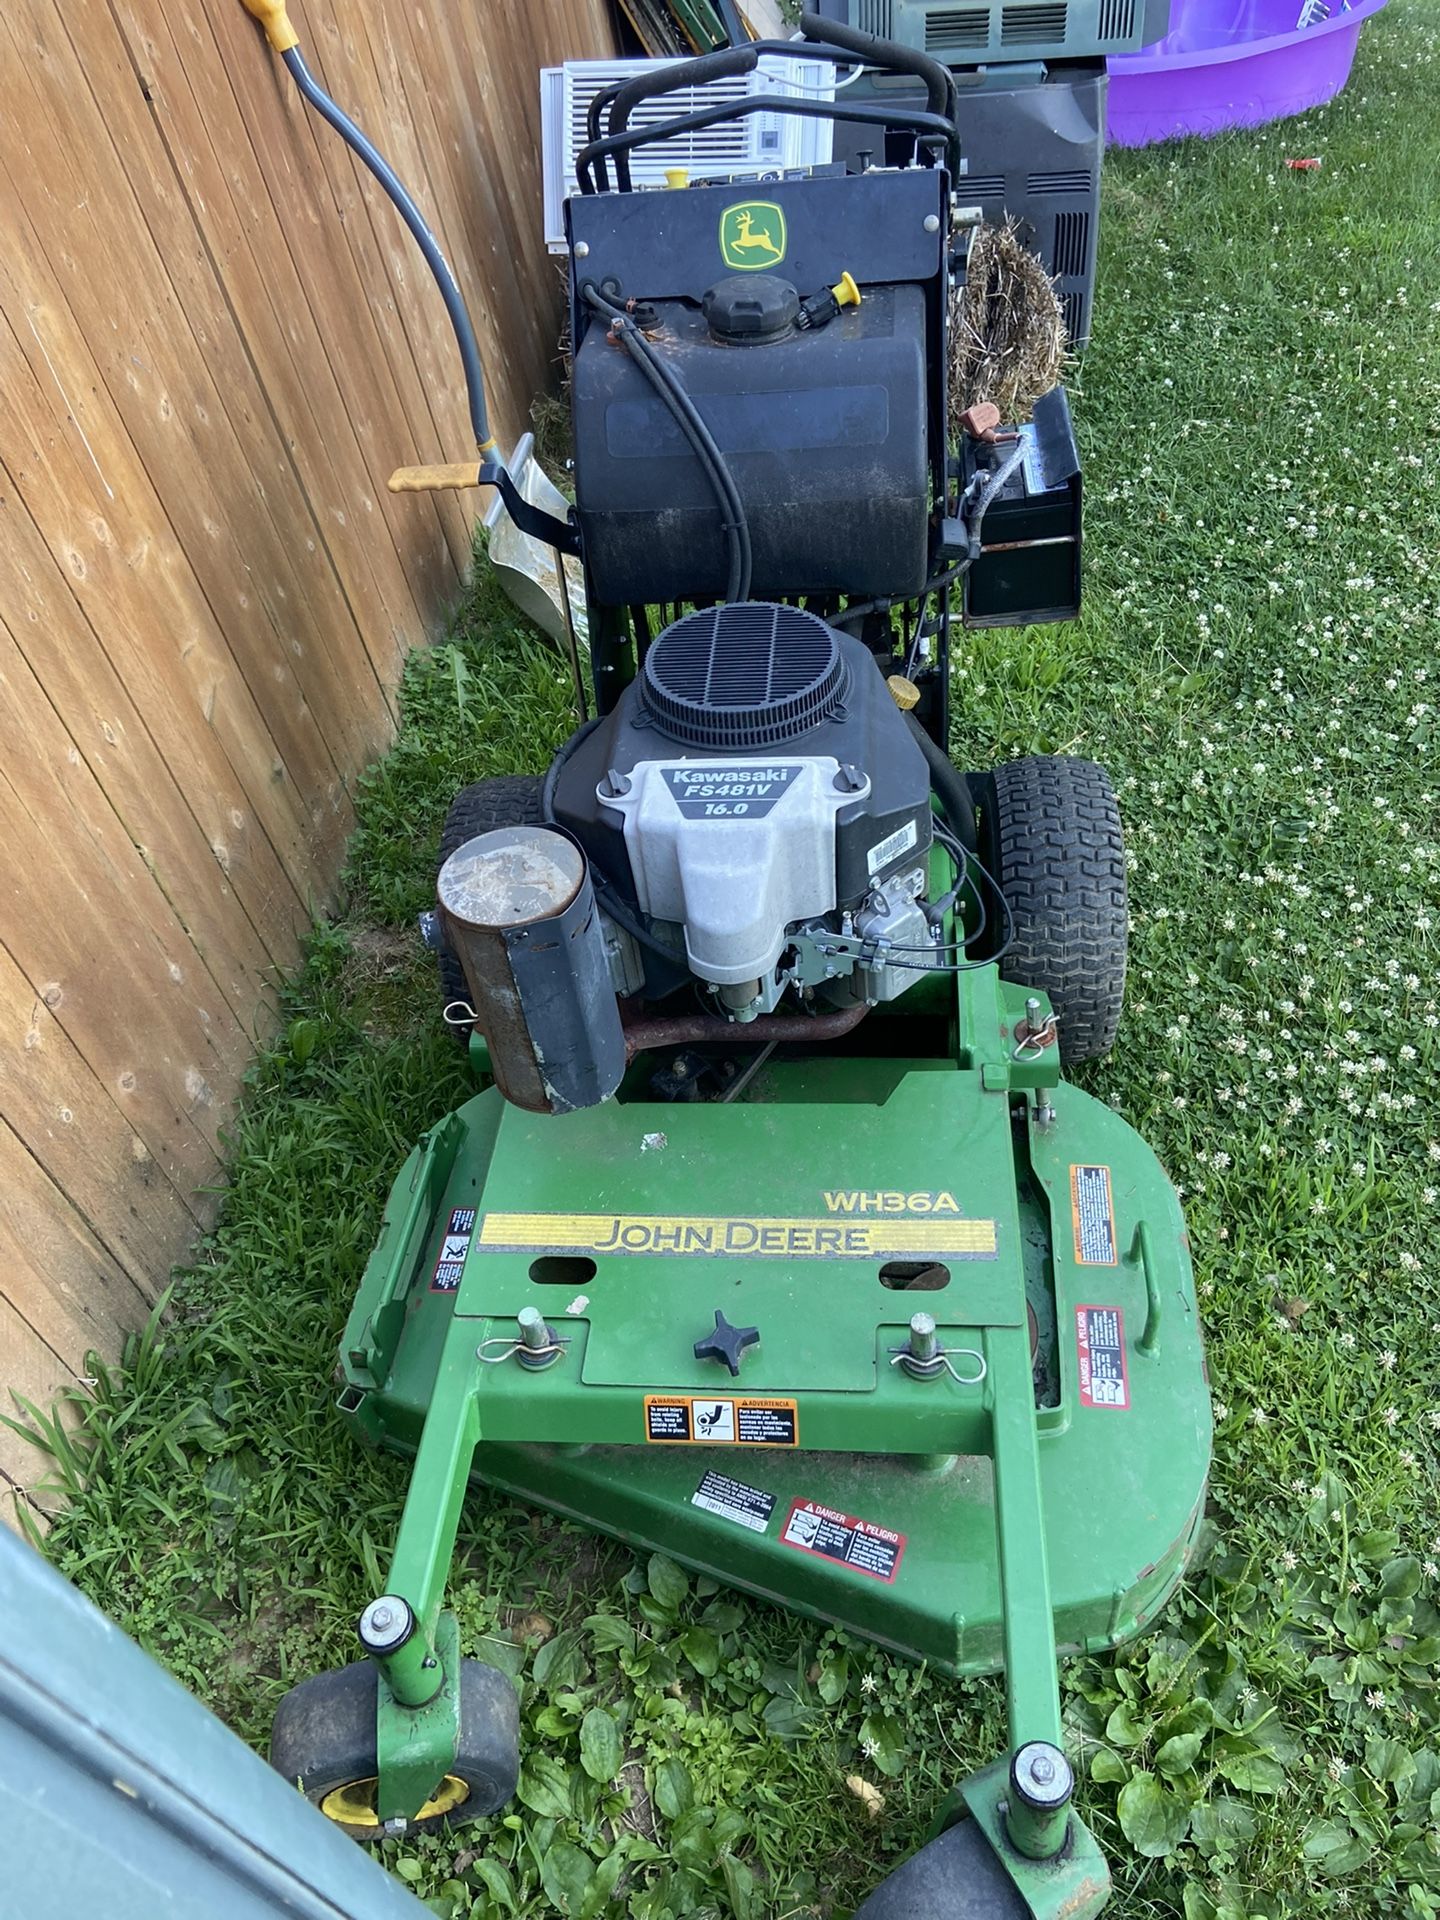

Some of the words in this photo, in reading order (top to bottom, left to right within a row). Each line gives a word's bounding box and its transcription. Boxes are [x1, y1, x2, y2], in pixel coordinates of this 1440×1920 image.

[673, 769, 788, 783] Kawasaki
[684, 784, 772, 796] FS481V
[705, 803, 748, 815] 16.0
[823, 1191, 960, 1213] WH36A
[594, 1219, 713, 1250] JOHN
[725, 1222, 870, 1252] DEERE
[1080, 1357, 1089, 1385] DANGER
[815, 1506, 846, 1523] DANGER
[866, 1525, 898, 1542] PELIGRO
